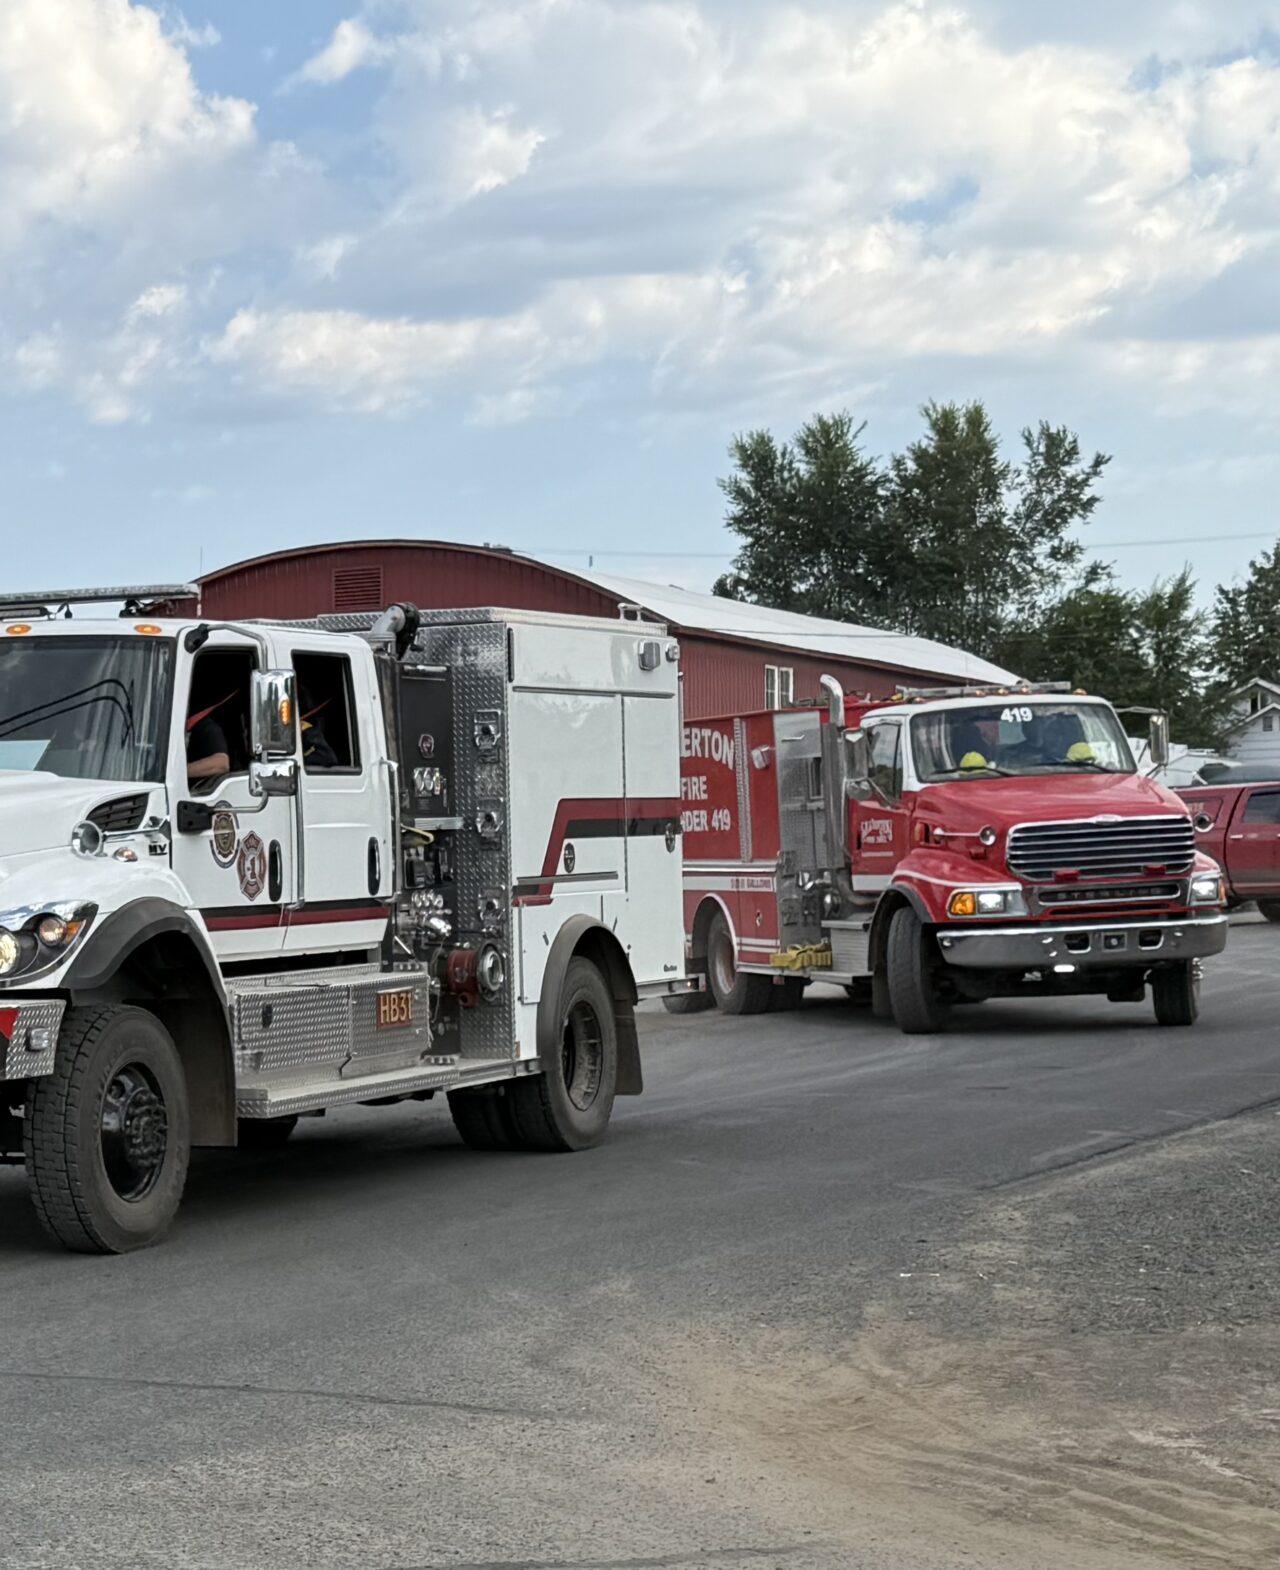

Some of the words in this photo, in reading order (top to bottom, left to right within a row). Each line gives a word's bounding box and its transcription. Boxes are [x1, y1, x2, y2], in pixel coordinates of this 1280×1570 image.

[1000, 707, 1033, 722] 419
[681, 775, 708, 800] FIRE
[711, 808, 731, 831] 419
[380, 992, 412, 1023] HB31
